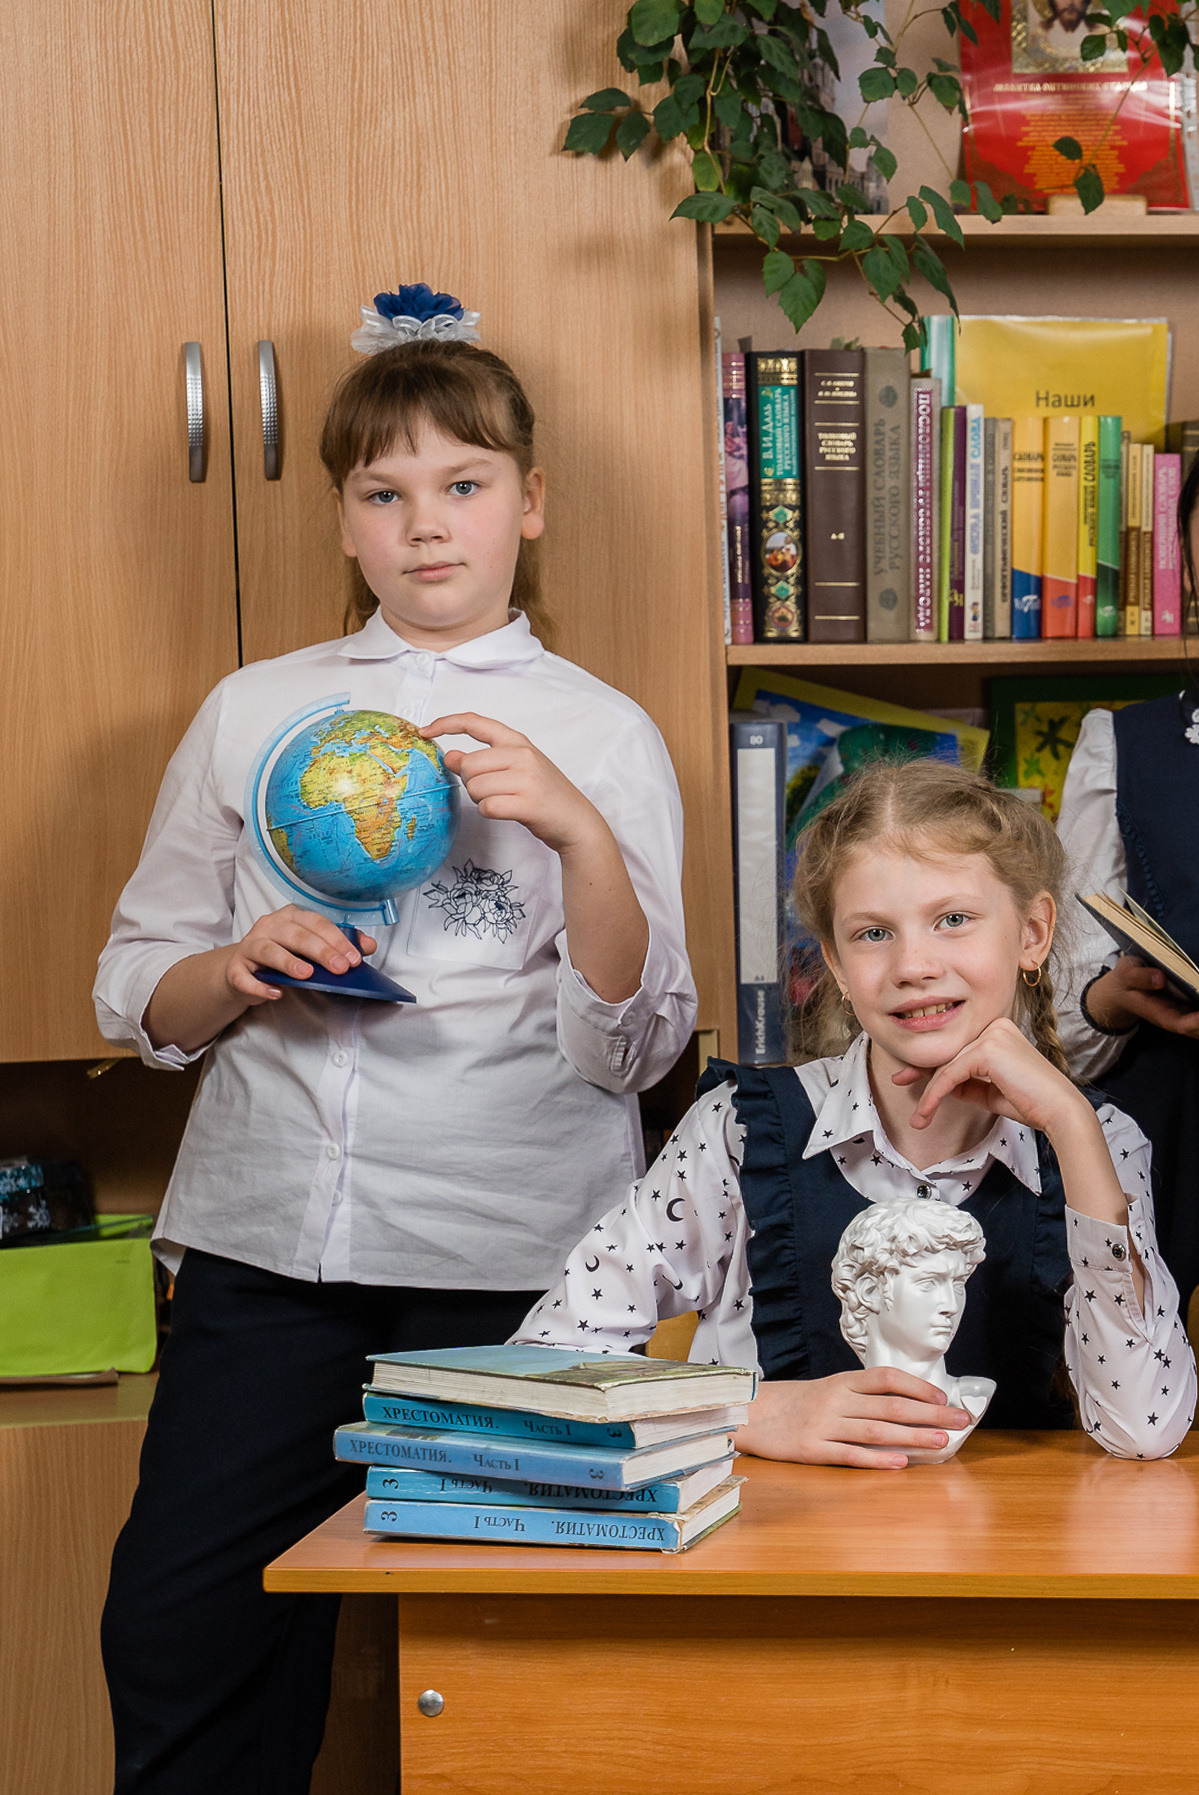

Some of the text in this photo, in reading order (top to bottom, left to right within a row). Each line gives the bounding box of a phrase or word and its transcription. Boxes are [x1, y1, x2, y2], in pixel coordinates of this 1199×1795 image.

[1035, 389, 1096, 408] Наши
[918, 393, 932, 487] ПОСЛОВИЦЫ
[970, 415, 981, 460] СЛОВА
[1084, 441, 1097, 484] СЛОВАРЬ
[873, 418, 887, 576] УЧЕБНЫЙ СЛОВАРЬ
[888, 424, 902, 571] РУССКОГО ЯЗЫКА
[918, 489, 932, 564] РУССКОГО
[382, 1405, 499, 1430] ХРЕСТОМАТИЯ.
[350, 1439, 452, 1463] ХРЕСТОМАТИЯ.
[382, 1477, 399, 1490] 3
[524, 1481, 658, 1503] ХРЕСТОМАТИЯ.
[380, 1510, 398, 1523] 3
[551, 1519, 666, 1541] ХРЕСТОМАТИЯ.
